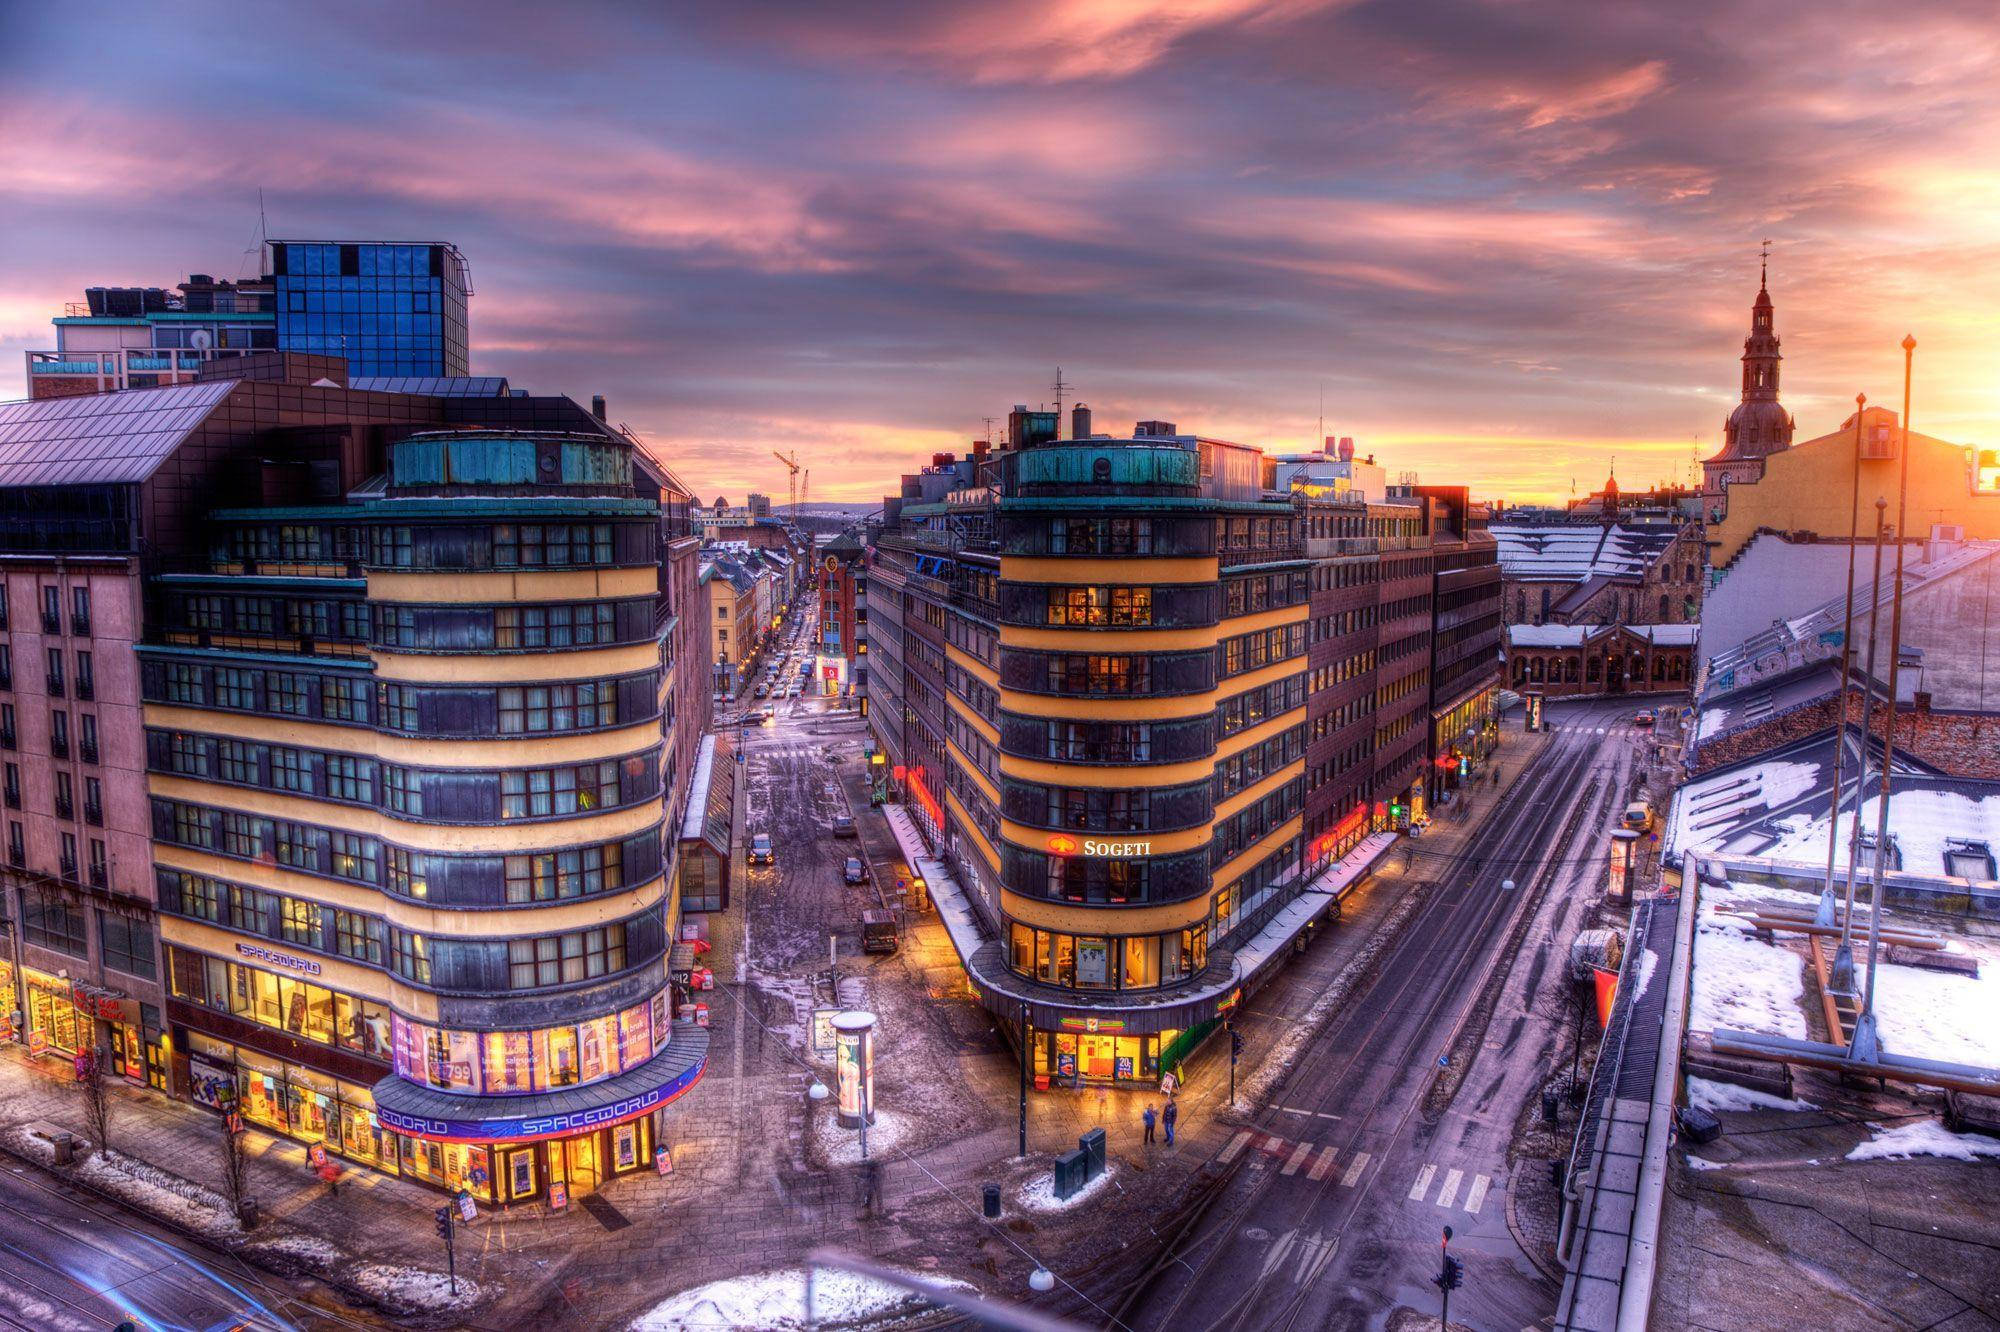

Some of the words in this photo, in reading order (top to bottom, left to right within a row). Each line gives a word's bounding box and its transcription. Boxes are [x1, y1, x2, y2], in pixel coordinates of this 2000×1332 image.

[1085, 842, 1151, 856] SOGETI
[240, 944, 320, 974] SPACEWORLD
[449, 1065, 471, 1080] 799
[523, 1090, 659, 1134] SPACEWORLD
